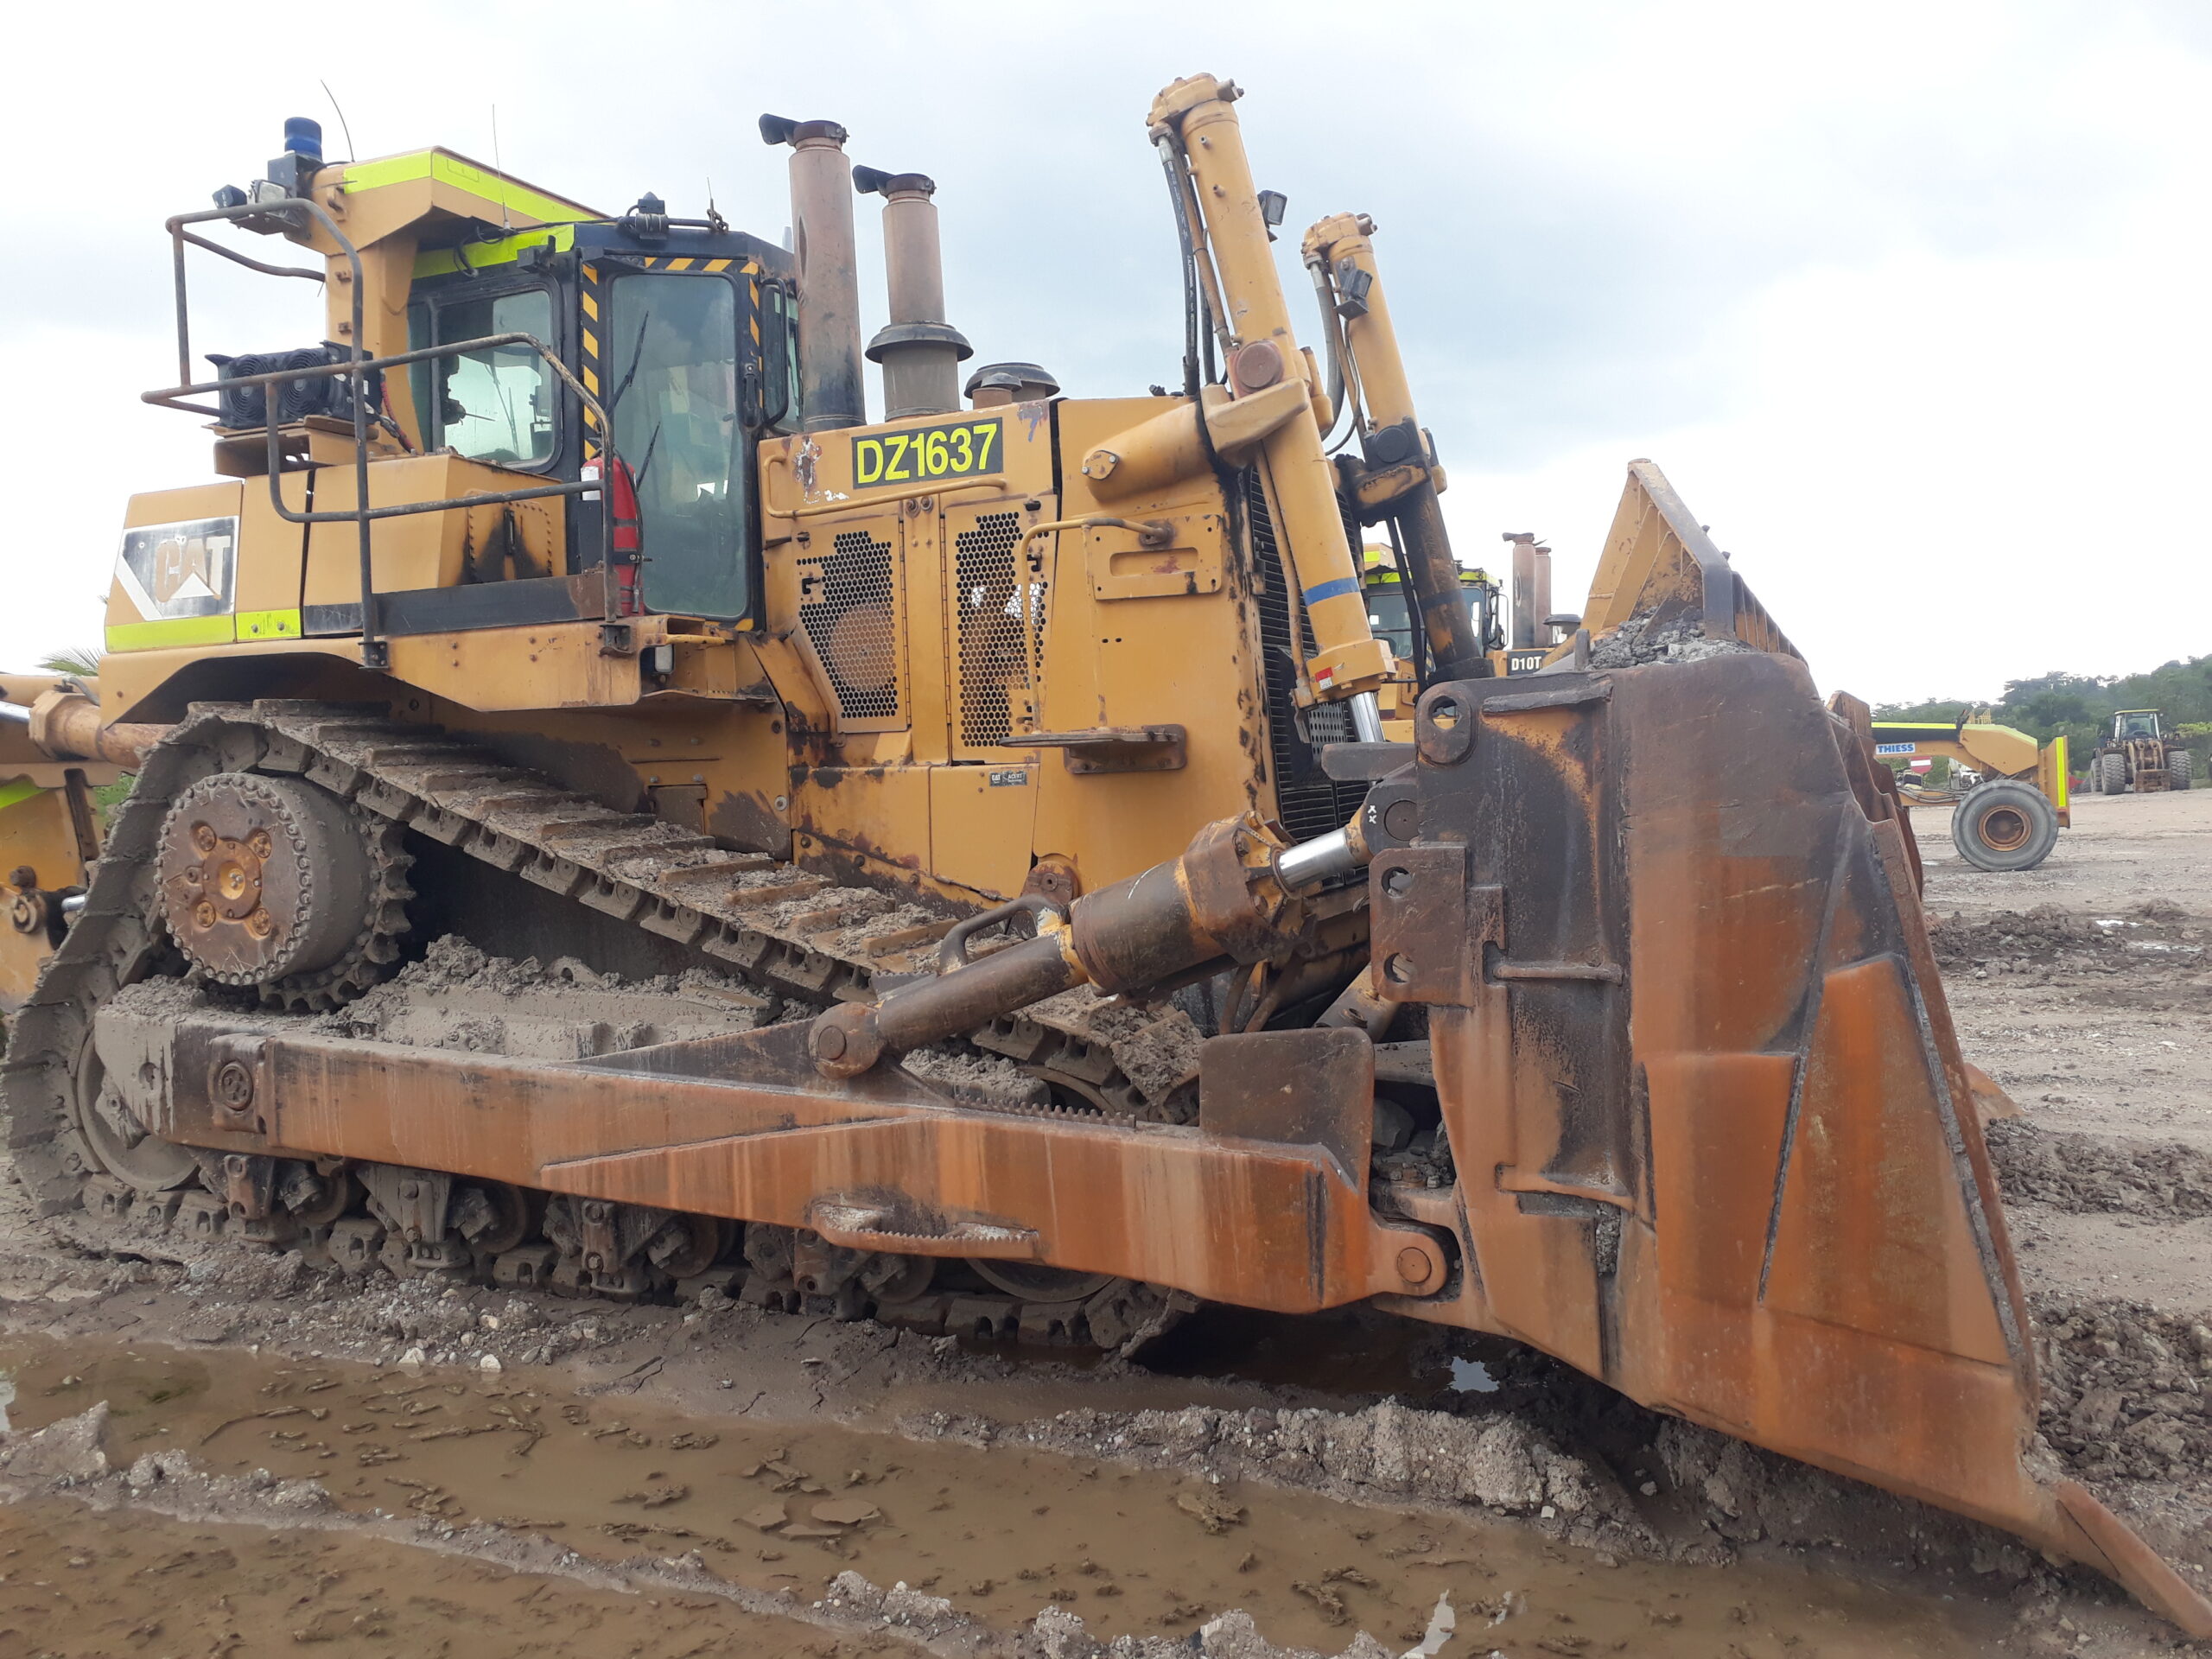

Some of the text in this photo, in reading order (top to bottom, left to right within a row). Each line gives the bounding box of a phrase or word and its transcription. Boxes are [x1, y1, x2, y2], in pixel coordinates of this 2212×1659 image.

[856, 423, 997, 484] DZ1637
[155, 536, 231, 603] CAT
[1511, 656, 1541, 671] D10T
[1878, 744, 1914, 753] THIESS
